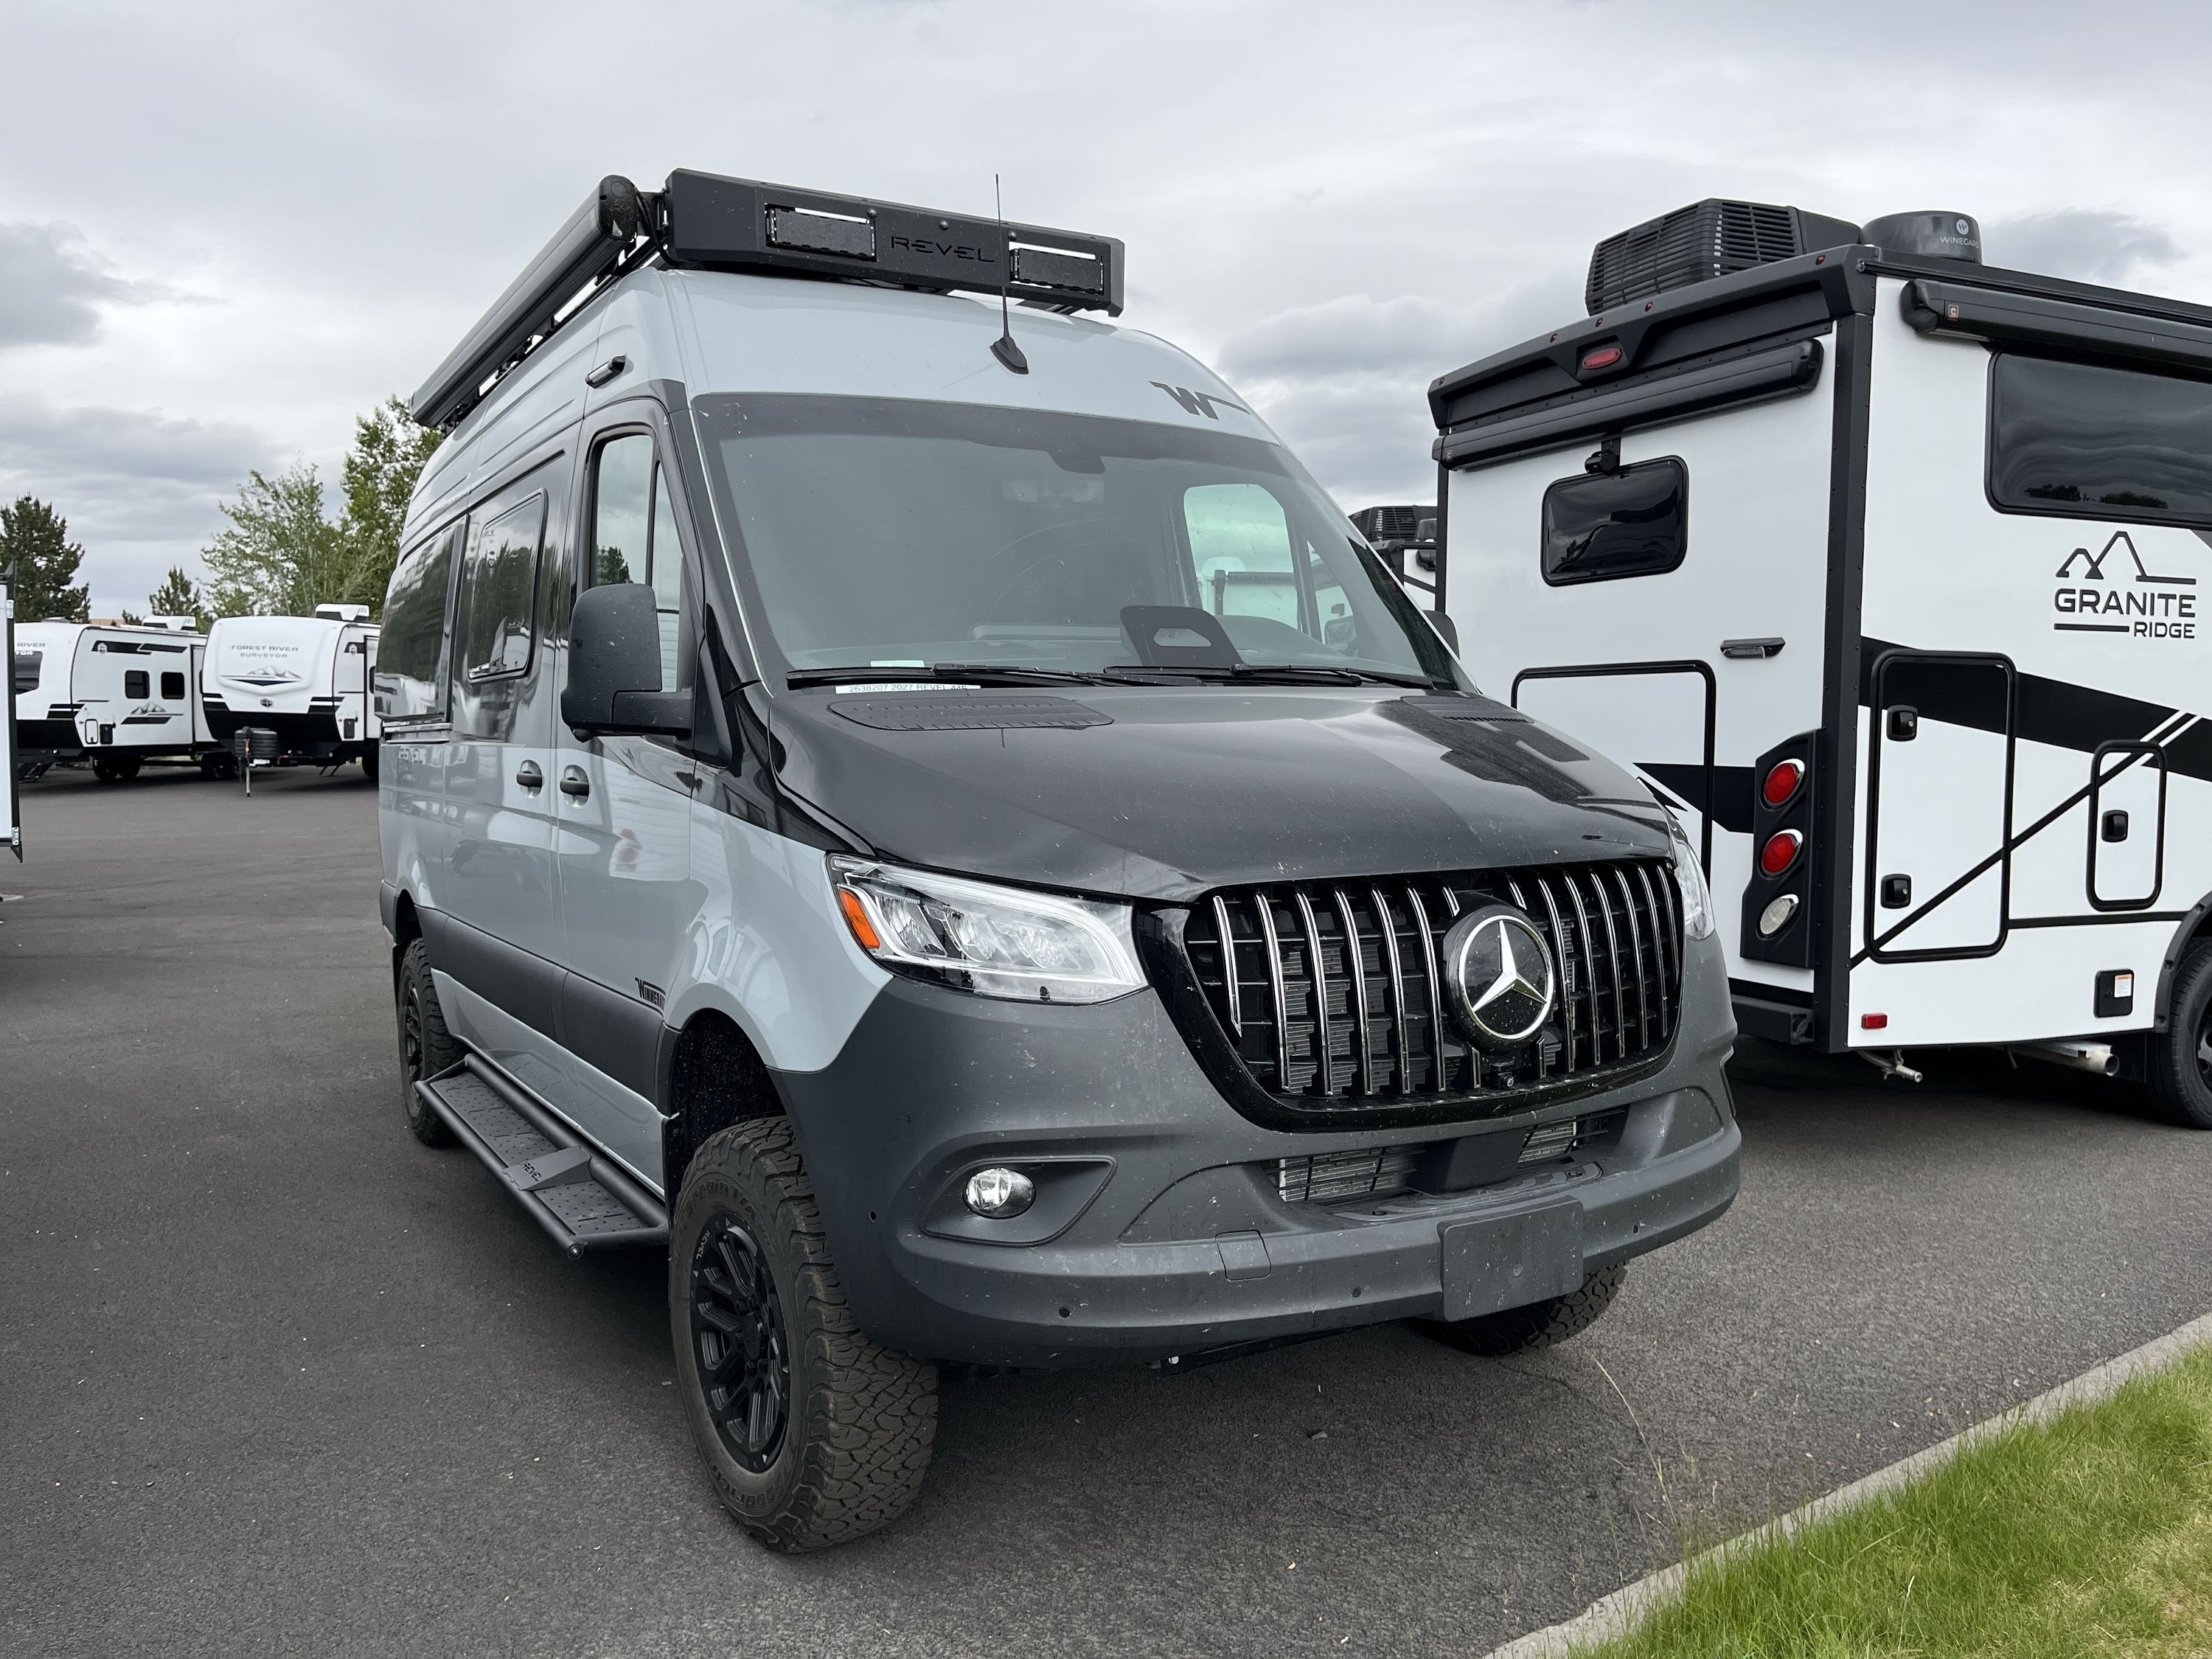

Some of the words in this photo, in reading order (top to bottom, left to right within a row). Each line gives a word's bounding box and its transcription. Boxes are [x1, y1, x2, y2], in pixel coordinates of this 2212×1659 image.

[891, 236, 995, 263] REVEL
[2054, 588, 2197, 618] GRANITE
[2133, 621, 2196, 639] RIDGE
[695, 1229, 711, 1260] REVEL
